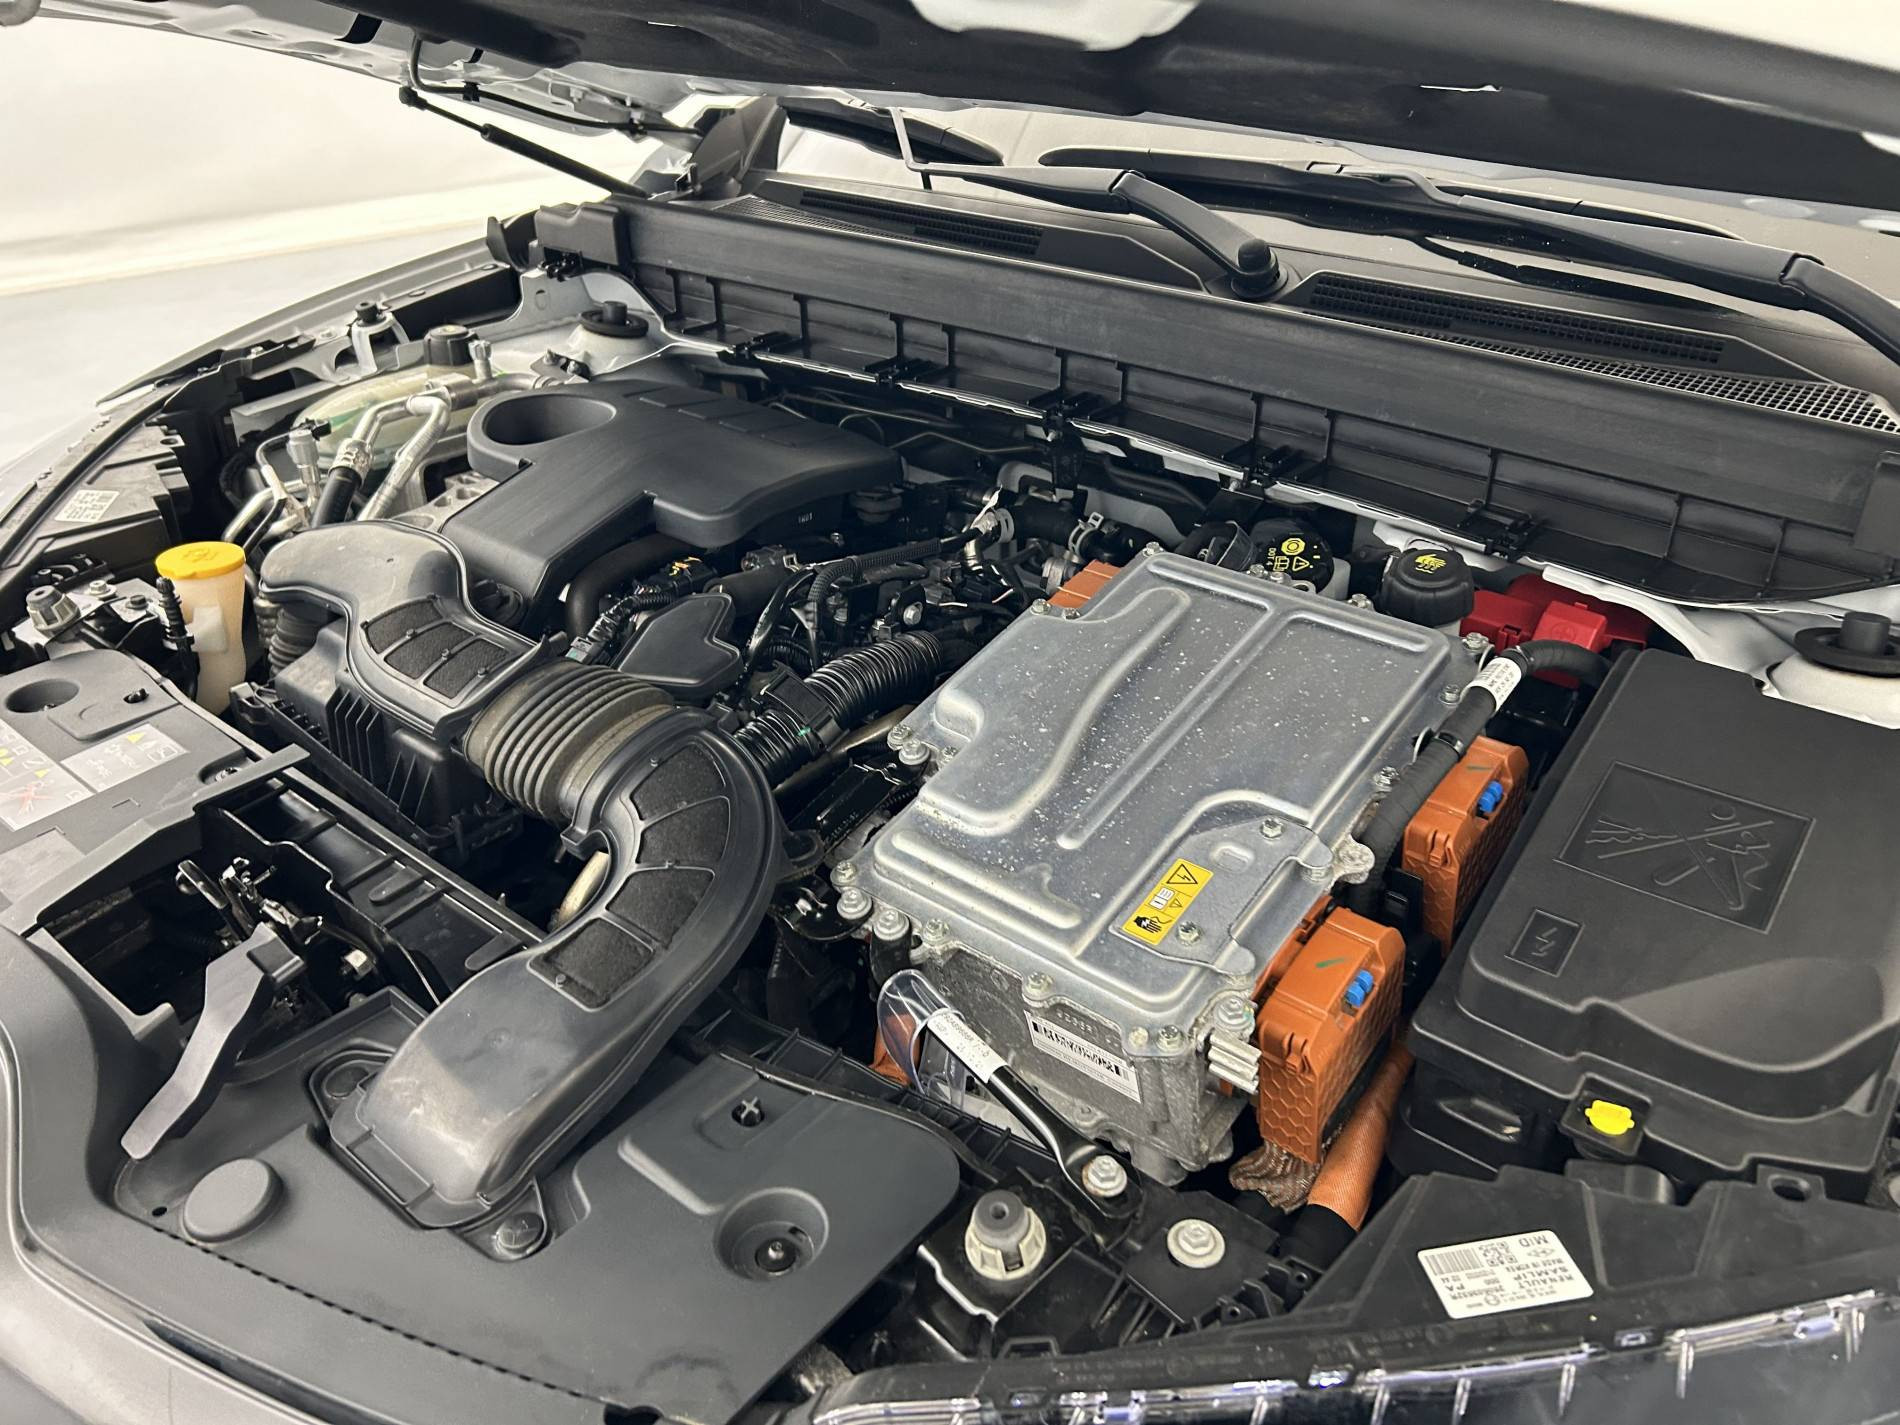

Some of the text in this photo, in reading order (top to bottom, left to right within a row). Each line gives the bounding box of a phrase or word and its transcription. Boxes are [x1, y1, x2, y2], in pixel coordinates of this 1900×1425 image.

[1267, 547, 1277, 560] DOT
[1517, 1234, 1549, 1247] MID
[1511, 1266, 1569, 1280] SAMLIP
[1516, 1273, 1574, 1288] RENAULT
